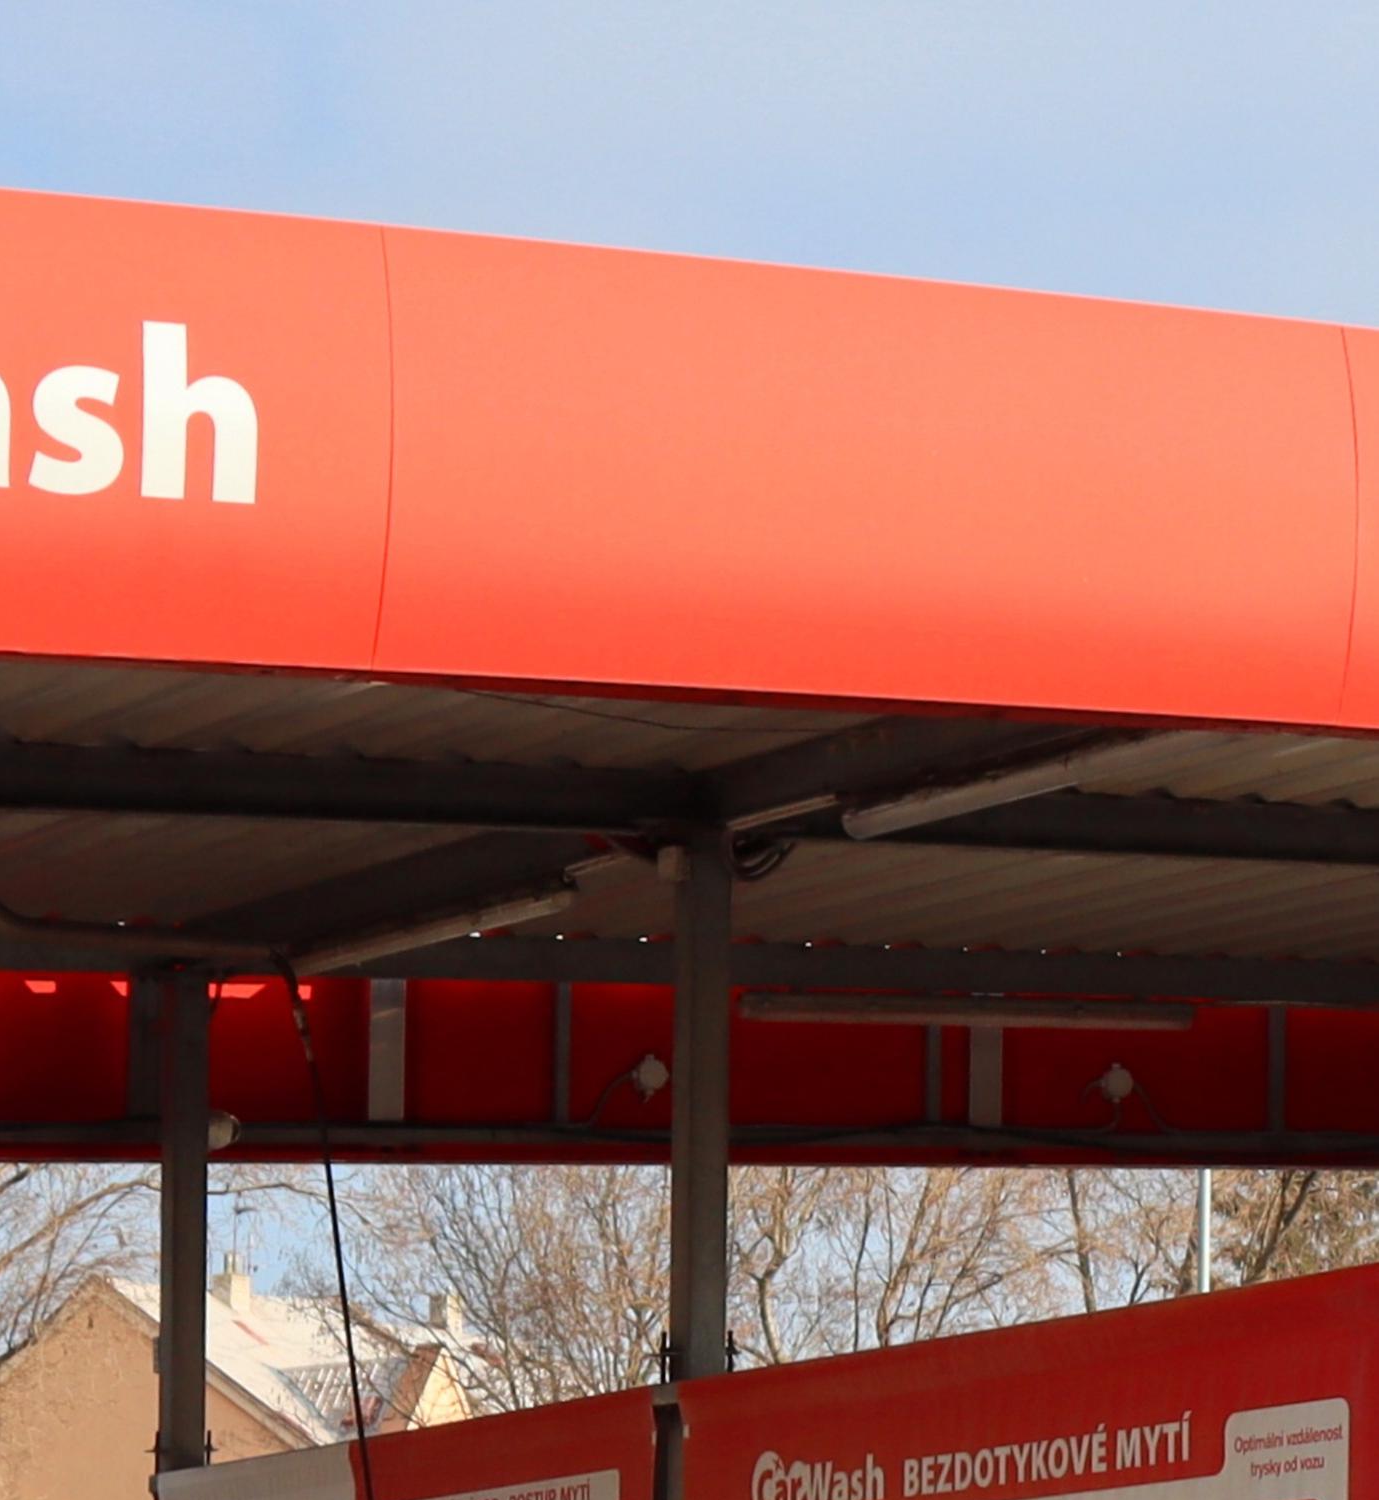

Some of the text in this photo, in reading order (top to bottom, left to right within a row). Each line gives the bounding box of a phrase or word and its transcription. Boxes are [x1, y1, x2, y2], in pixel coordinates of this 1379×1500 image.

[903, 1423, 1108, 1499] BEZDOTYKOVÉ
[1115, 1411, 1193, 1471] MYTÍ
[1233, 1424, 1344, 1455] Optimální vzdálenost
[1250, 1456, 1325, 1480] trysky od vozu
